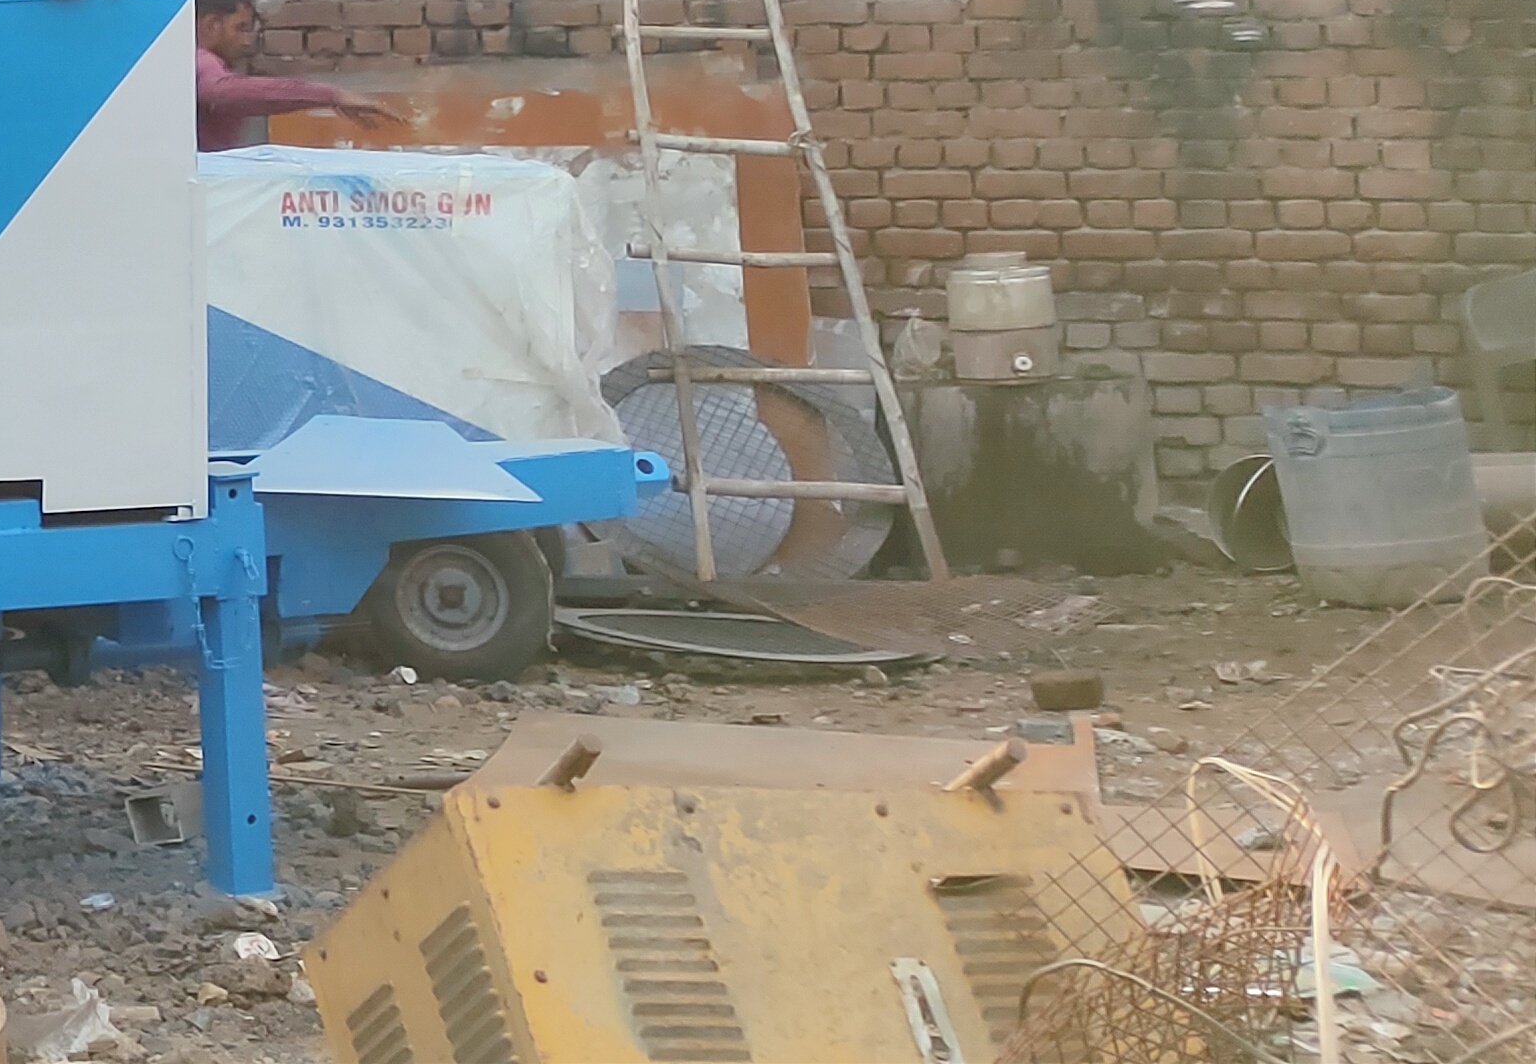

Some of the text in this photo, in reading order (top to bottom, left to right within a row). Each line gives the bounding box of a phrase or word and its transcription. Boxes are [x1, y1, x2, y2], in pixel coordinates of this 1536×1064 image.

[280, 190, 340, 215] ANTI
[349, 189, 427, 215] SMOG
[281, 215, 453, 229] M. 931353223
